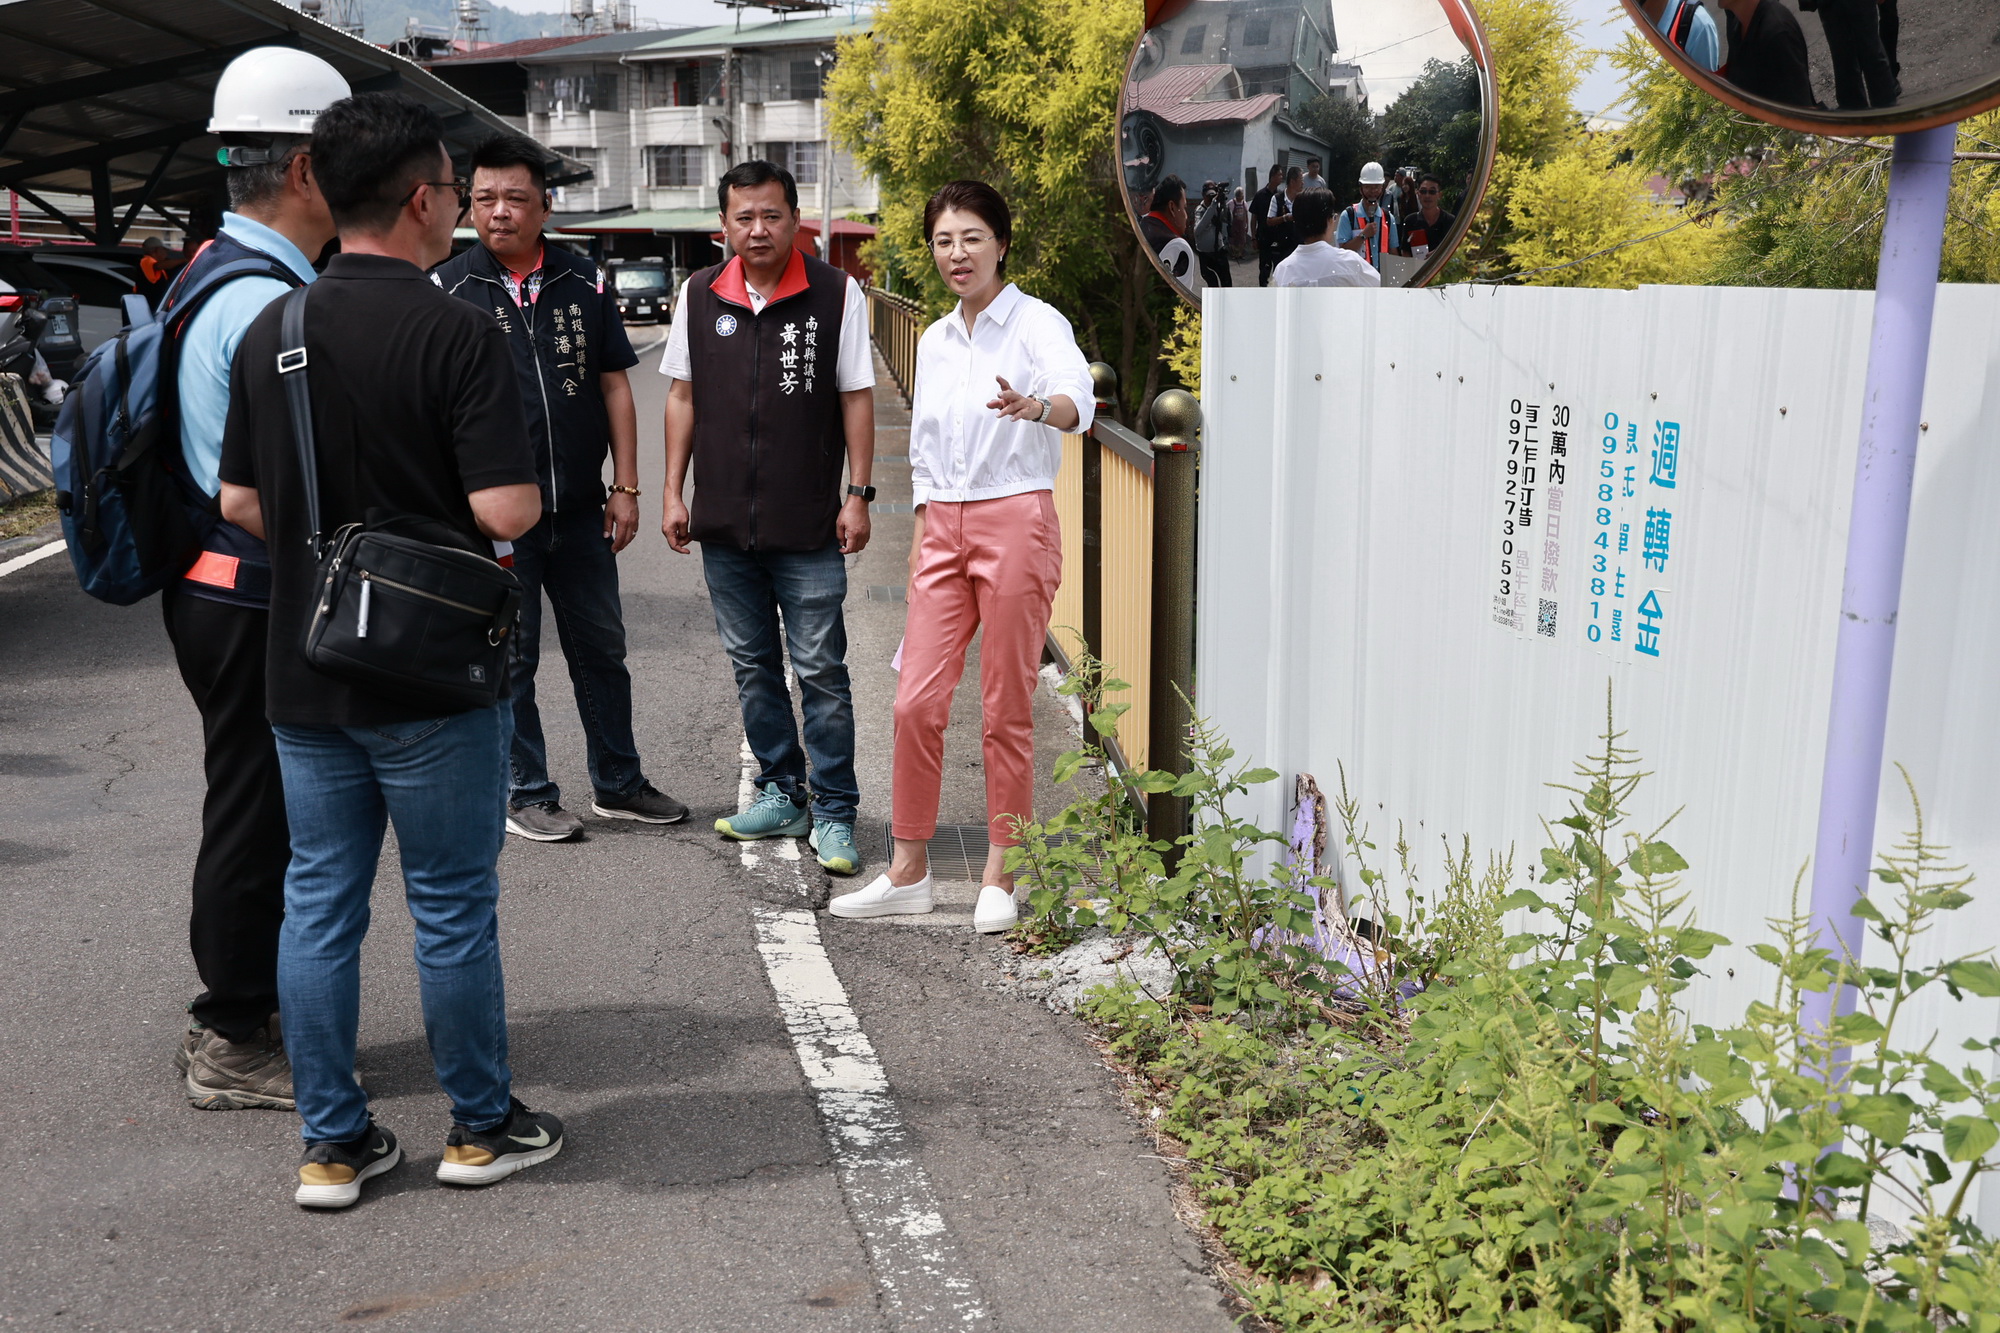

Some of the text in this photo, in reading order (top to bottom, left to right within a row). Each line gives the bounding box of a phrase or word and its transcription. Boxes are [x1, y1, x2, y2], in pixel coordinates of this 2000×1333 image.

[495, 306, 512, 333] 主任
[569, 303, 587, 380] 南投縣議會
[779, 322, 800, 395] 黃世芳
[803, 315, 818, 394] 南投縣議員
[554, 335, 578, 396] 潘一全
[1500, 398, 1522, 595] 0979273053
[1587, 412, 1619, 643] 0958843810
[1634, 419, 1680, 657] 週轉金
